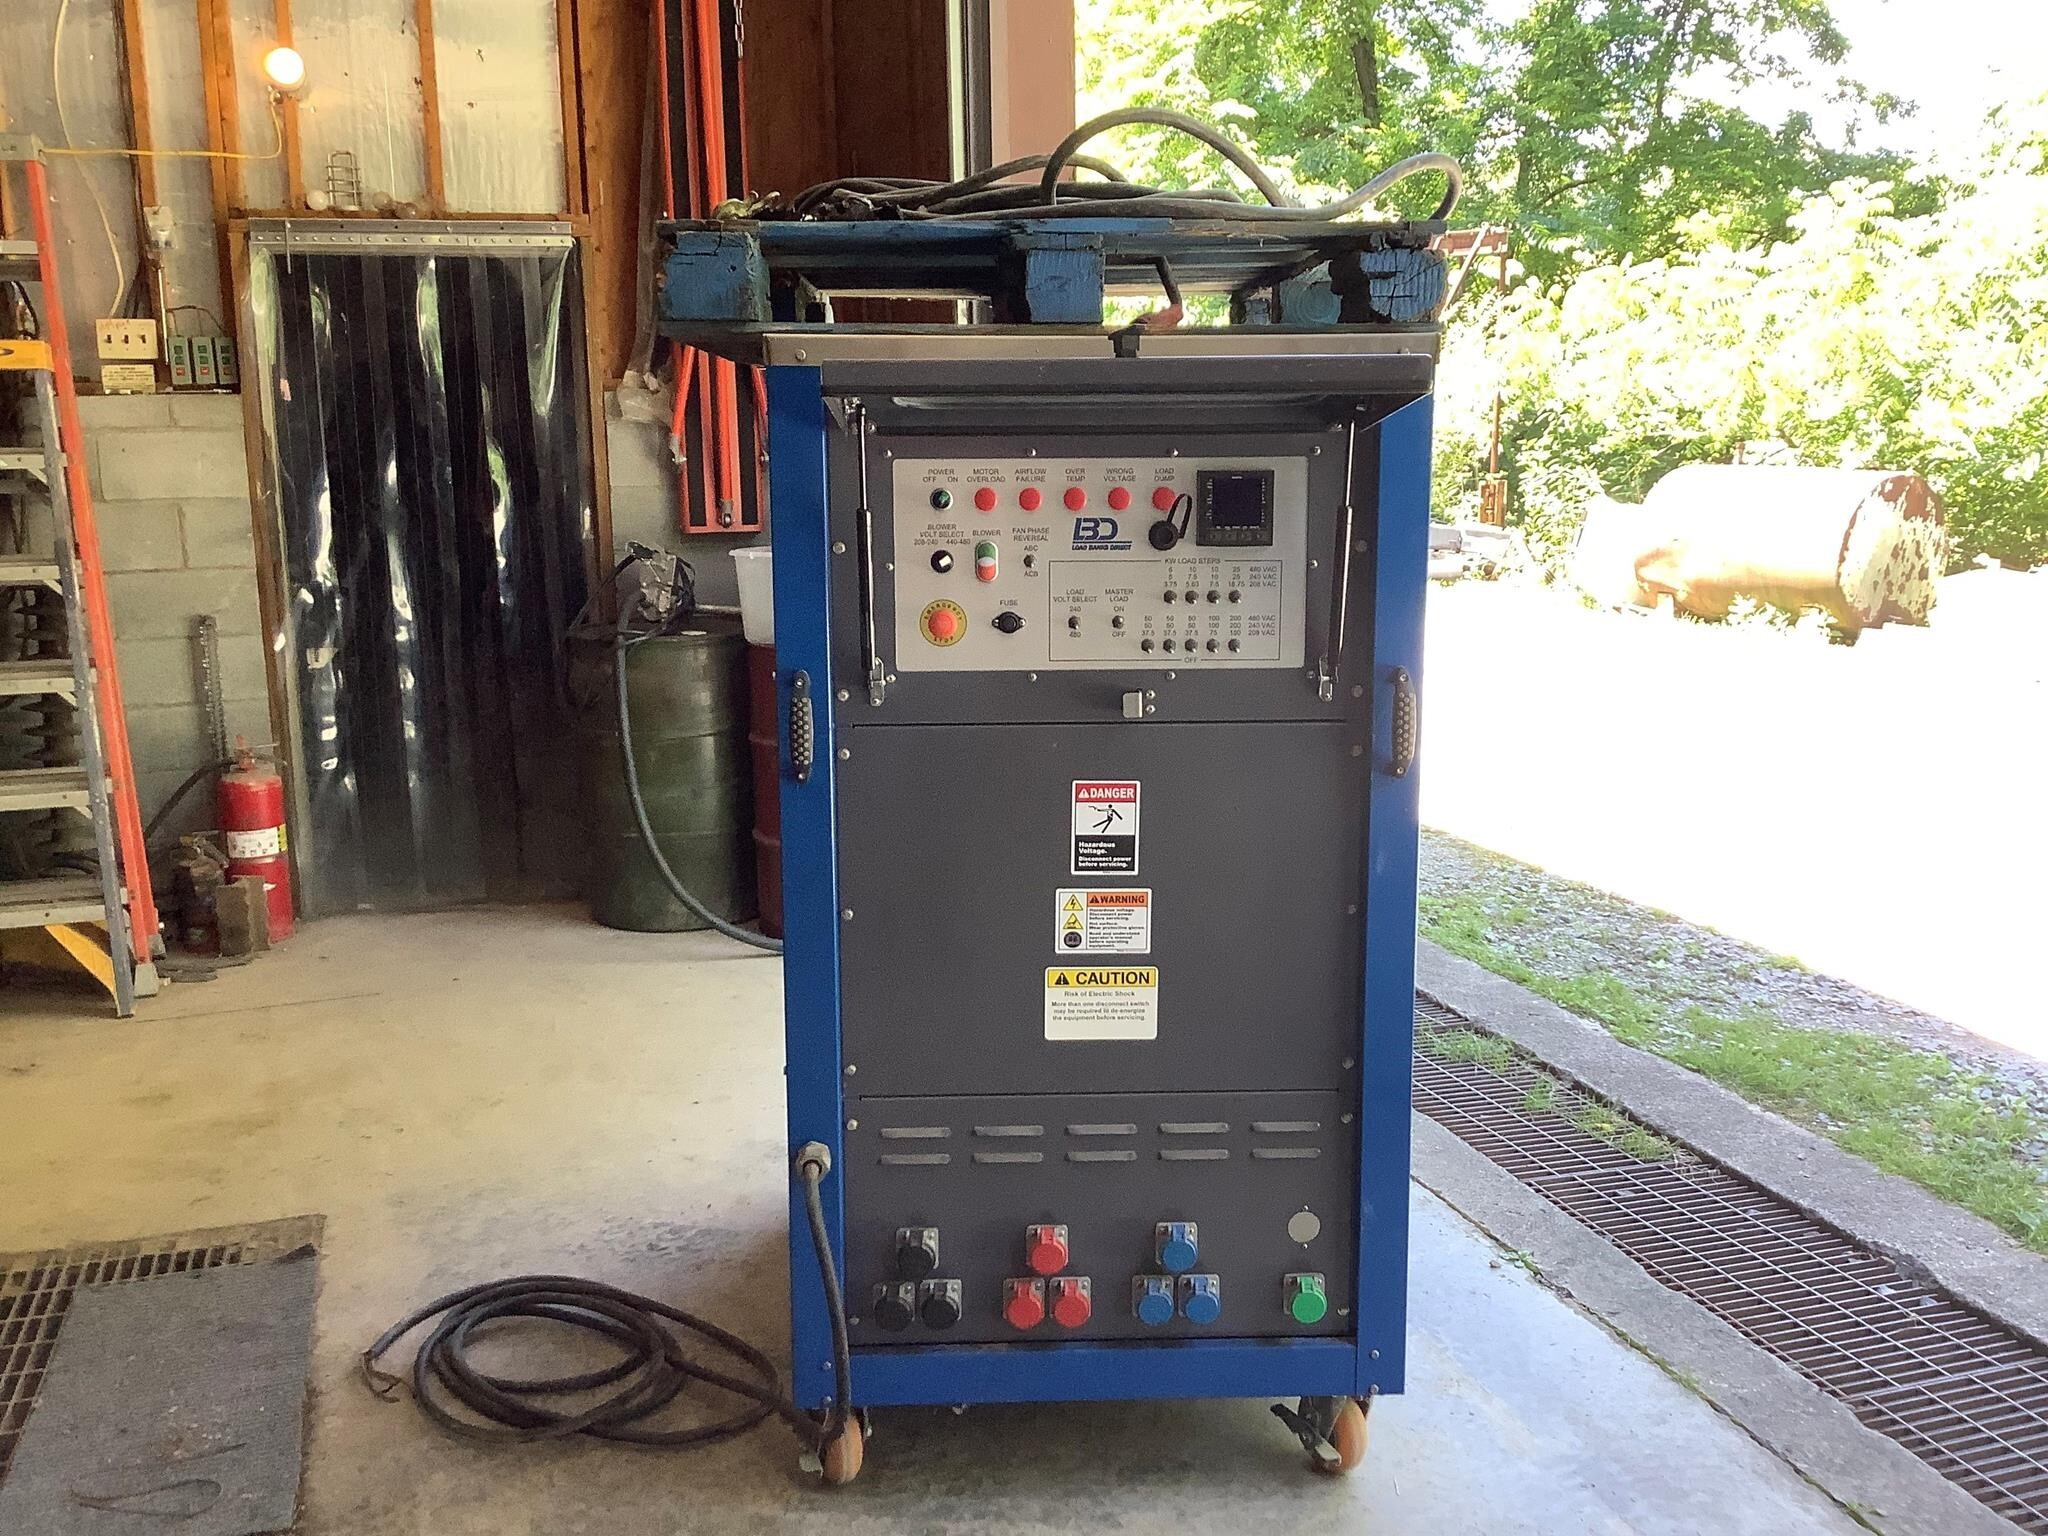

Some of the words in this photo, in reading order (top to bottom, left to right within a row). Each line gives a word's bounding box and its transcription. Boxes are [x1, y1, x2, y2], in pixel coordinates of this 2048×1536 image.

[924, 602, 962, 620] EMERGENCY
[1090, 788, 1134, 798] DANGER
[1101, 895, 1144, 903] WARNING
[1076, 972, 1149, 984] CAUTION
